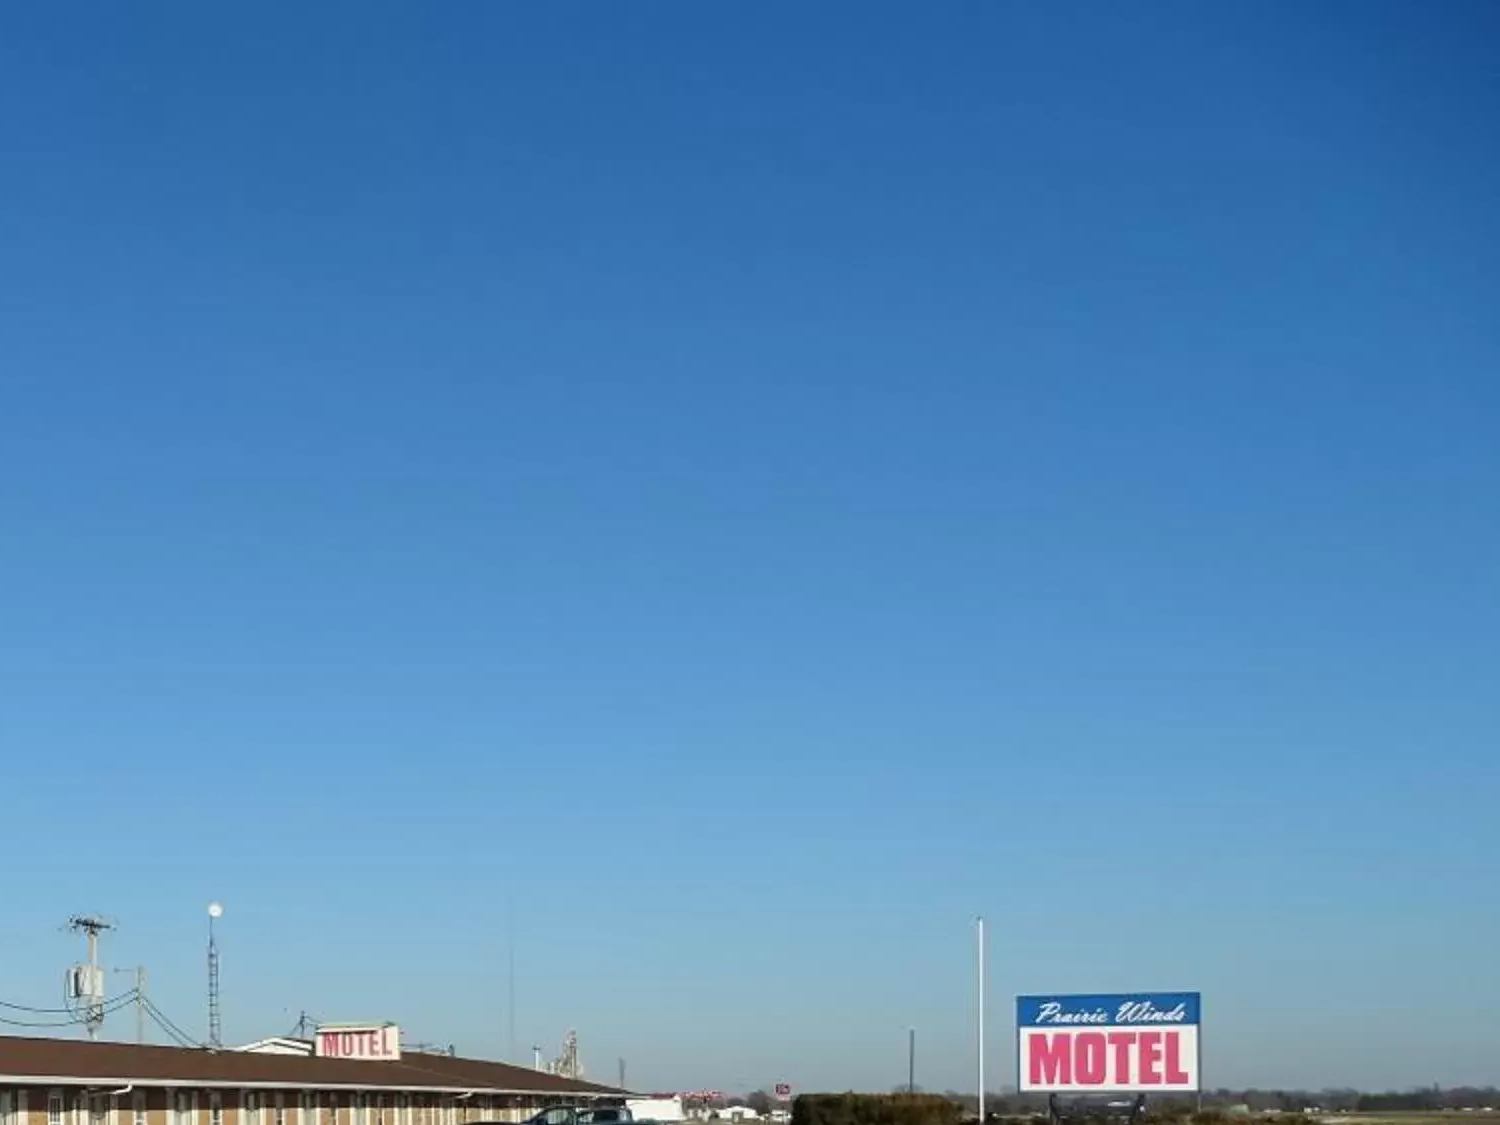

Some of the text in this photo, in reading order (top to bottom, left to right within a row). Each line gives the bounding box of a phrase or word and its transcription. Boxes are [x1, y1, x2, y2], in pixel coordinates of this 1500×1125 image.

[1034, 1001, 1186, 1024] Prairie Winds
[323, 1028, 392, 1057] MOTEL
[1029, 1031, 1189, 1085] MOTEL
